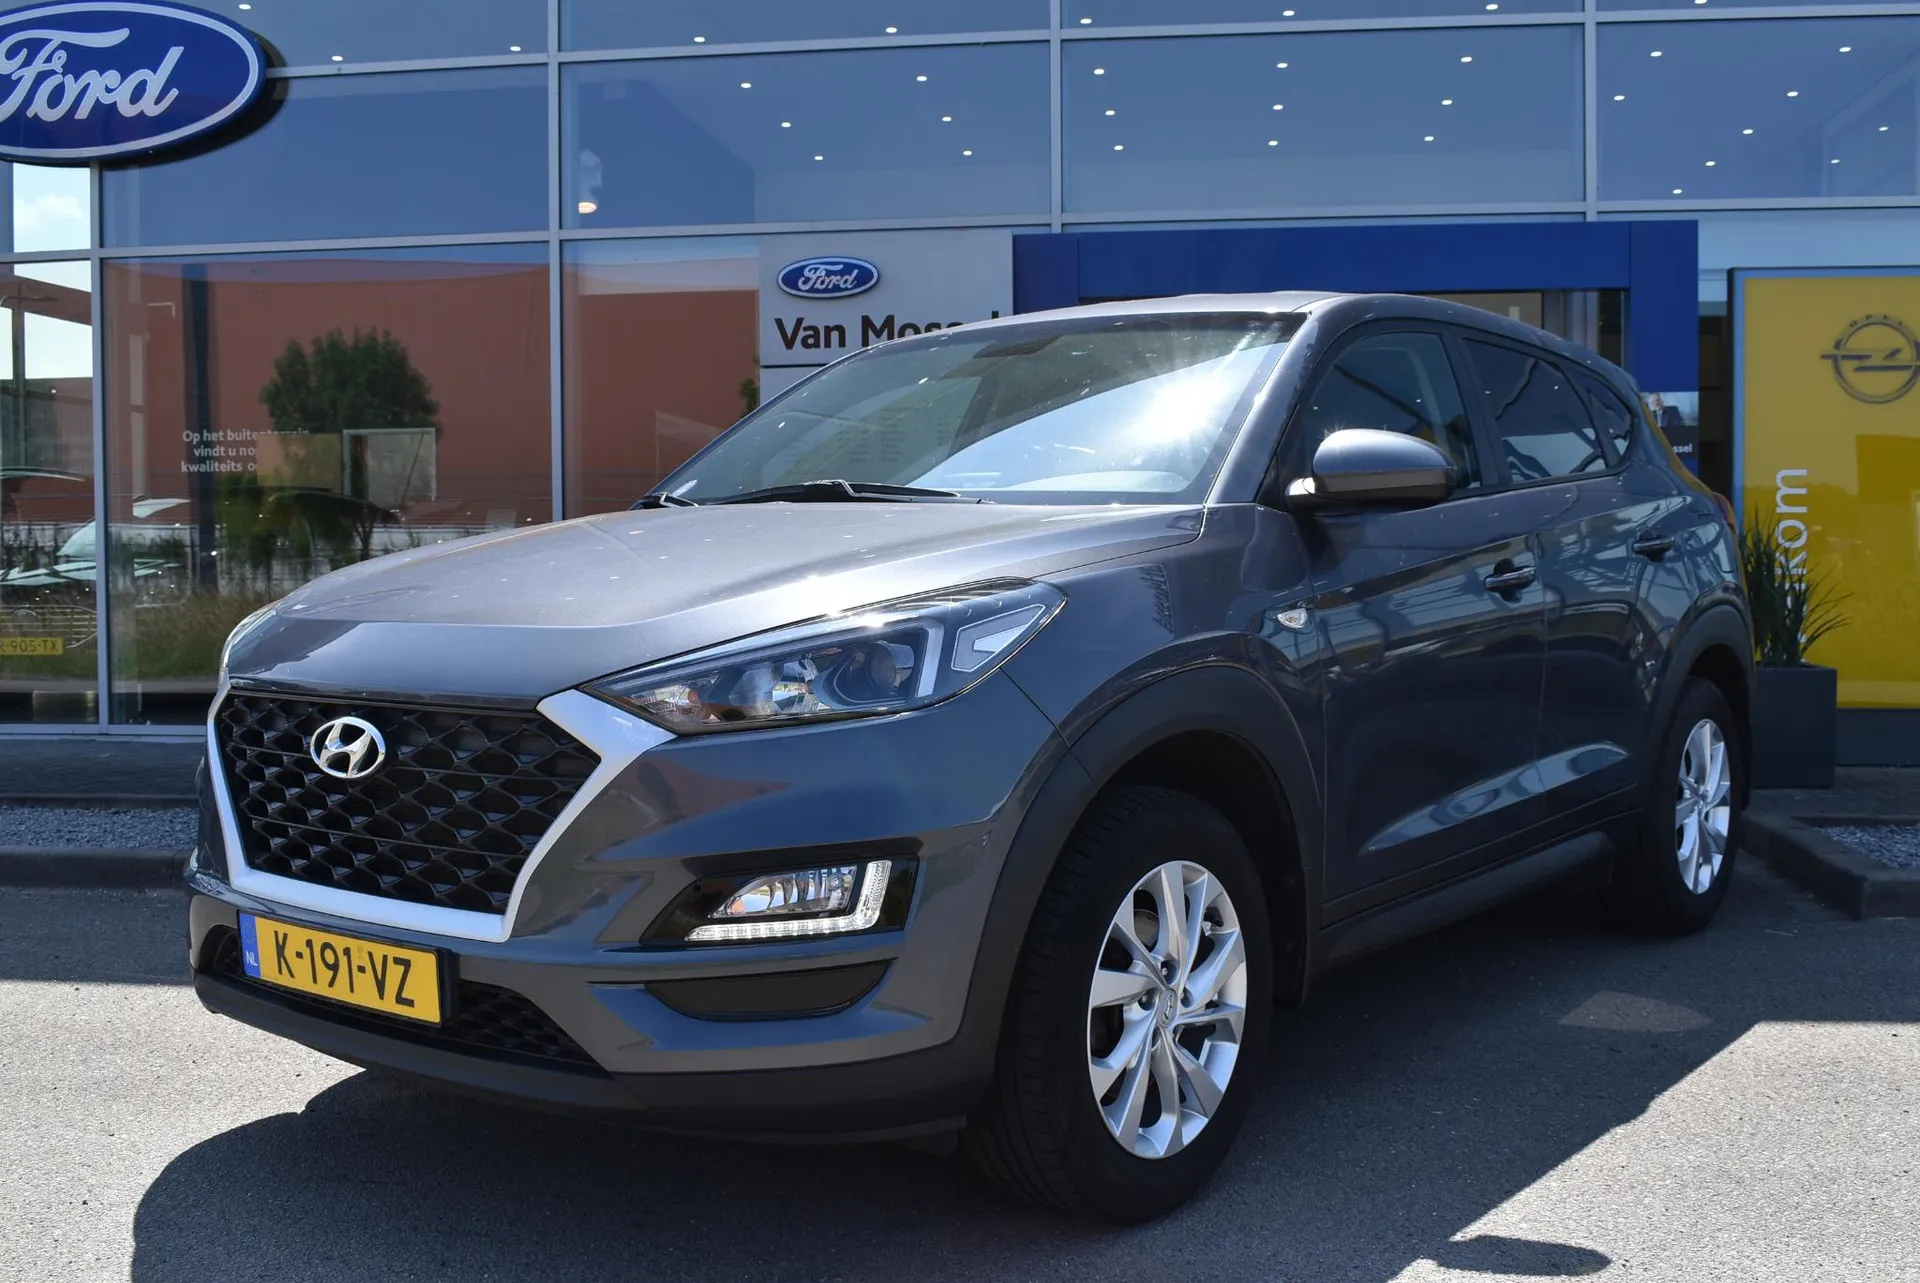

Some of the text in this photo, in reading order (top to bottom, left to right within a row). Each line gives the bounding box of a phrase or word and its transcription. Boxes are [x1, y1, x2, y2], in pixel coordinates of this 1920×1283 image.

[0, 28, 184, 123] Ford
[798, 264, 857, 290] Ford
[774, 317, 846, 350] Van
[182, 430, 200, 445] Op
[203, 429, 224, 441] het
[193, 445, 257, 460] vindt u no
[1672, 443, 1693, 453] ssel
[181, 460, 242, 473] kwaliteits
[245, 951, 258, 966] NL
[273, 930, 415, 1008] K-191-VZ
